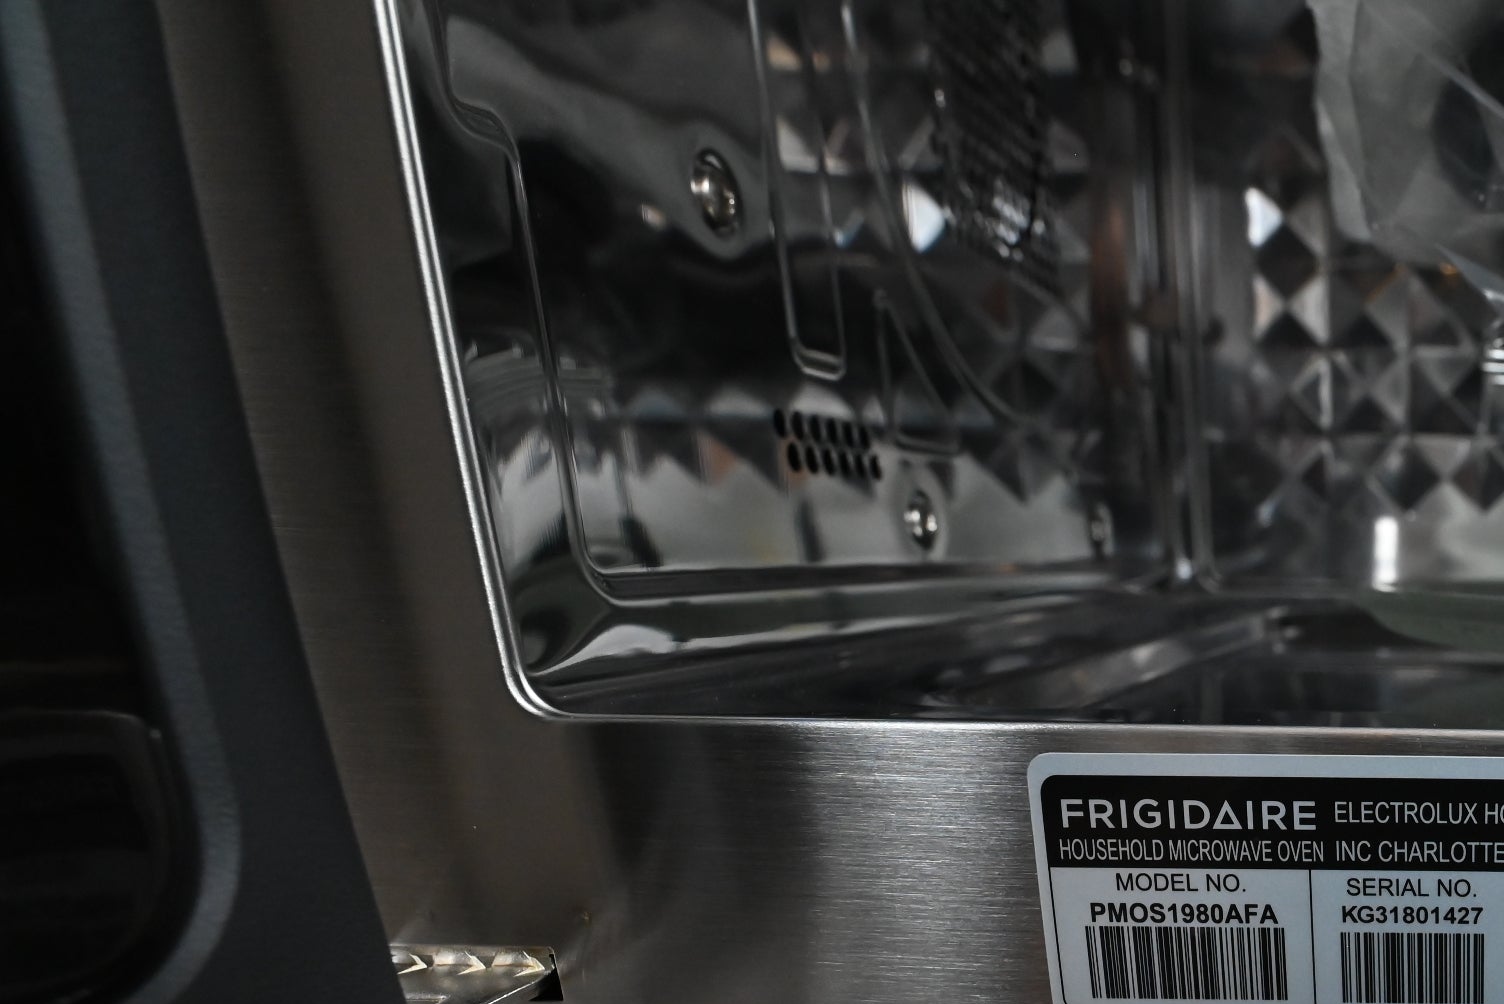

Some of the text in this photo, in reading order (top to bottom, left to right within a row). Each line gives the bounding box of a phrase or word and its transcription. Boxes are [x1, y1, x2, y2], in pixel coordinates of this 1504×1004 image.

[1060, 798, 1318, 831] FRIGIDAIRE
[1334, 800, 1478, 825] ELECTROLUX
[1059, 837, 1325, 863] HOUSEHOLD MICROWAVE OVEN
[1335, 840, 1372, 862] INC
[1115, 872, 1247, 893] MODEL NO.
[1346, 878, 1478, 898] SERIAL NO.
[1089, 902, 1279, 926] PMOS1980AFA
[1341, 905, 1485, 926] KG31801427
